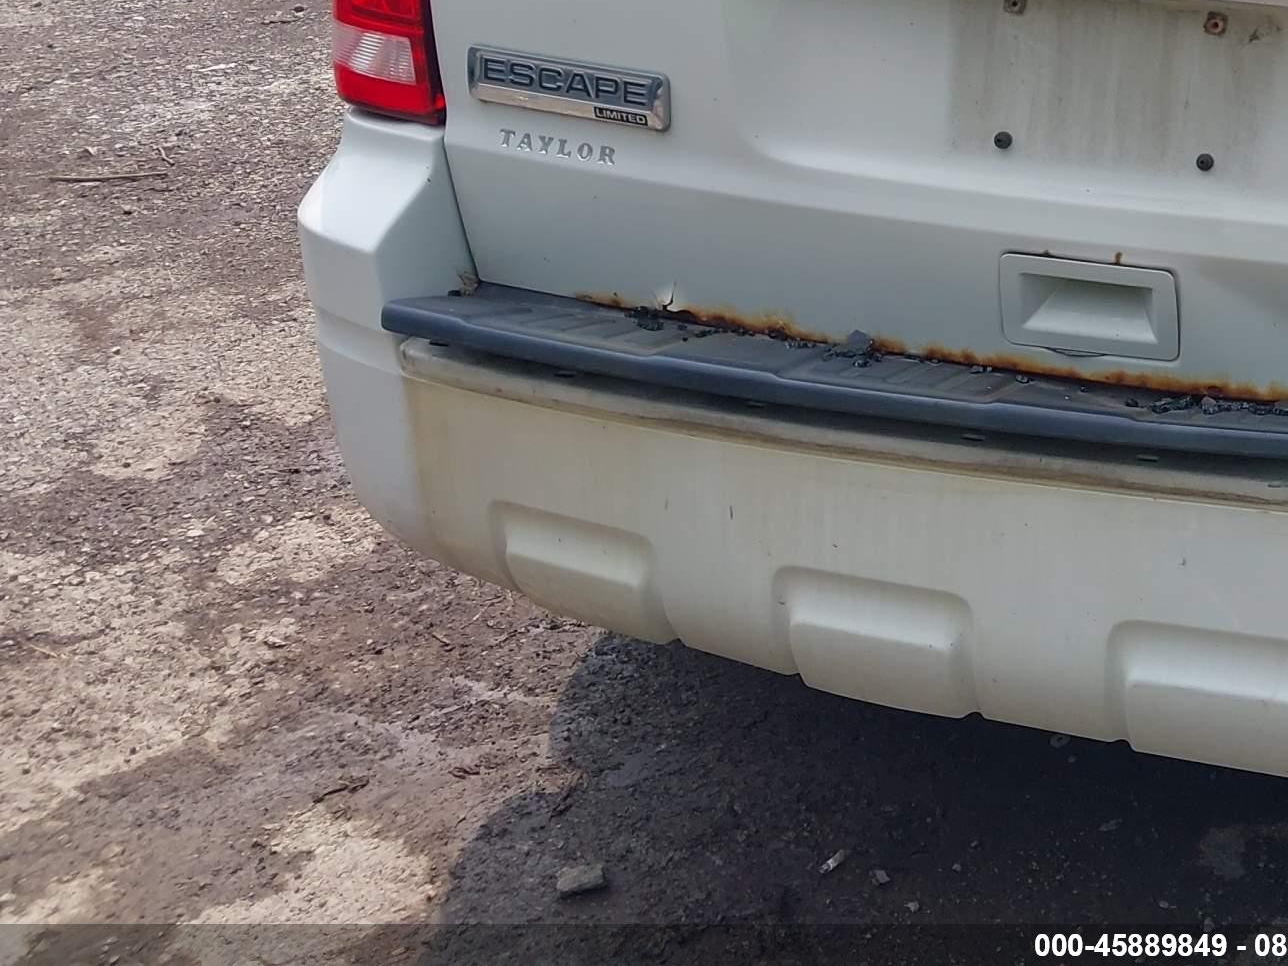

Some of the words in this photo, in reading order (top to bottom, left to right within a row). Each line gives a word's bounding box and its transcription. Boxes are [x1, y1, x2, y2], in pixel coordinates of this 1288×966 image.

[483, 56, 647, 107] ESCAPE
[595, 108, 647, 125] LIMITED
[500, 128, 616, 165] TAYLOR
